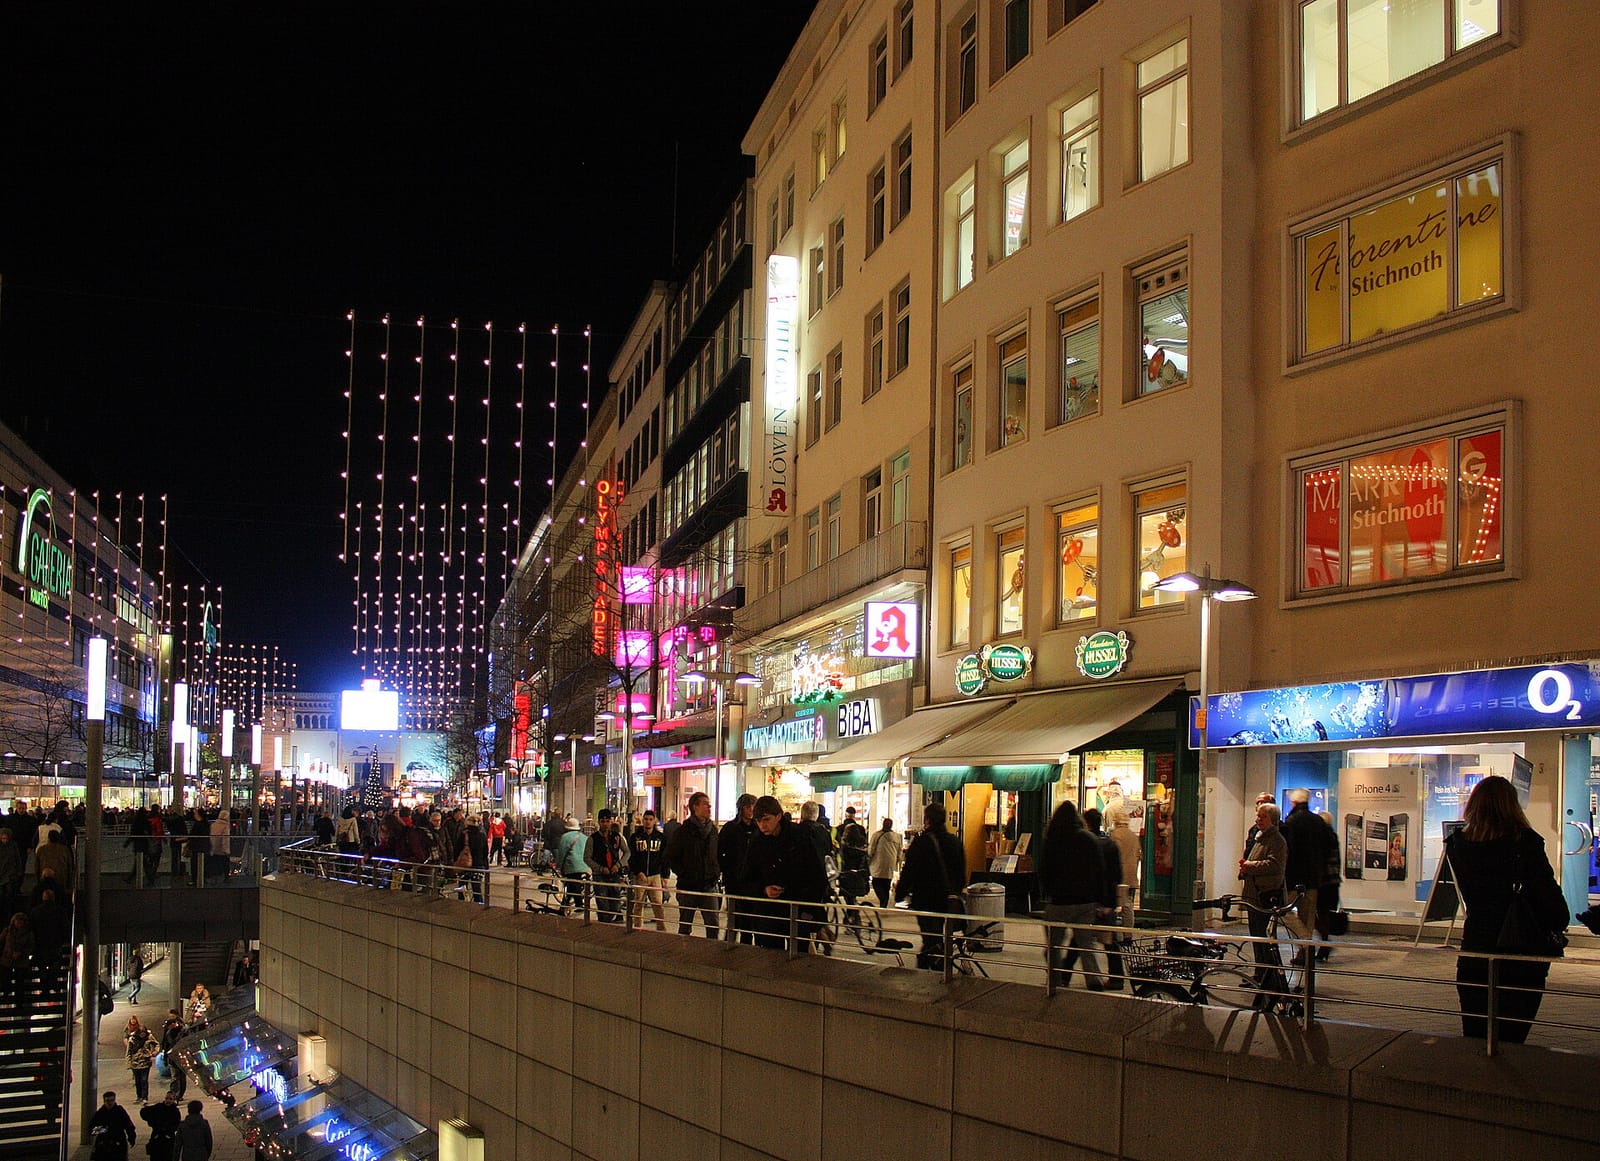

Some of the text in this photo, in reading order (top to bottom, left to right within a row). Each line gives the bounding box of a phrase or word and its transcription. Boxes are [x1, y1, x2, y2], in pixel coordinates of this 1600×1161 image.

[1310, 202, 1497, 291] Florentine
[1352, 250, 1443, 297] Stichnoth
[1329, 494, 1445, 530] by Stichnoth
[30, 532, 71, 600] GALERIA
[991, 657, 1023, 669] HUSSEL
[1085, 647, 1119, 665] HUSSEL
[960, 669, 981, 682] HUSSEL
[743, 717, 815, 750] LÖWEN-APOTHEKE
[838, 699, 873, 737] BiBA
[1354, 783, 1384, 794] iPhone
